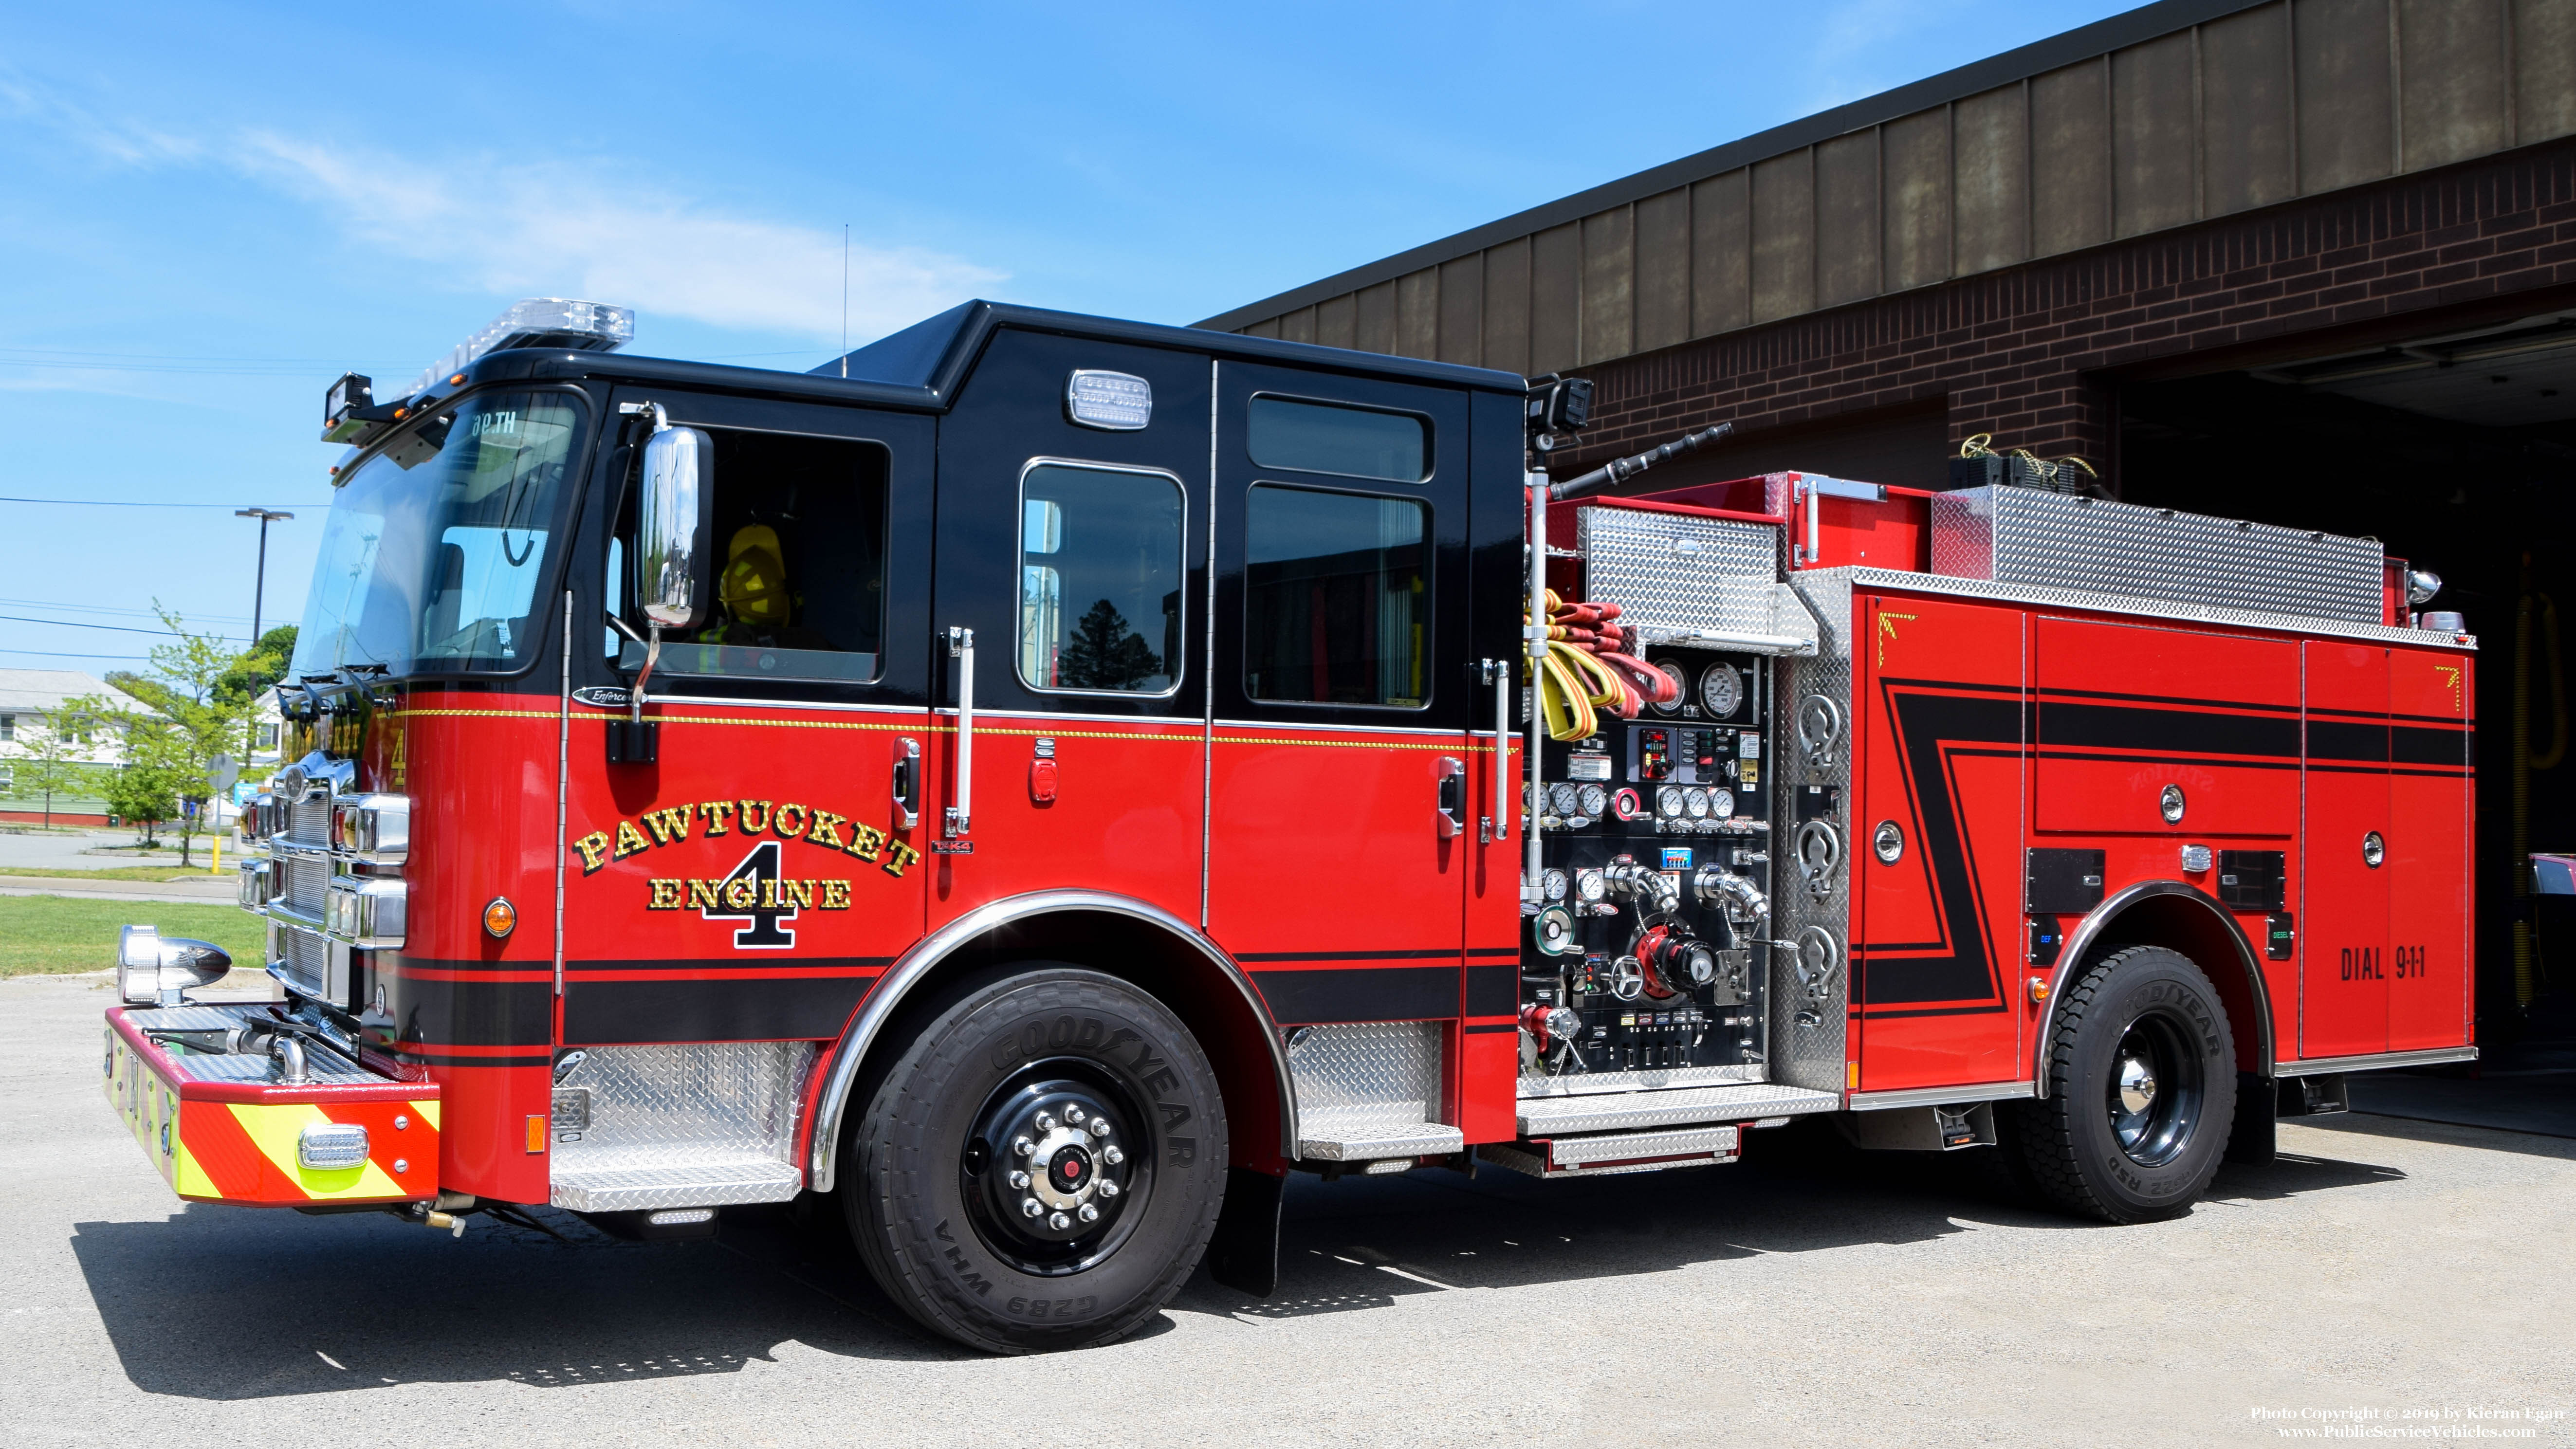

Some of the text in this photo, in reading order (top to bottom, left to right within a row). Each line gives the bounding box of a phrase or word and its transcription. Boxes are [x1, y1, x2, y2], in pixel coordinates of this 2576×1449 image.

[391, 729, 405, 786] 4
[572, 800, 921, 877] PAWTUCKET
[646, 879, 851, 911] ENGINE
[701, 841, 798, 949] 4
[2341, 947, 2384, 981] DIAL
[2111, 984, 2220, 1057] GOODYEAR
[991, 1013, 1197, 1169] GOODYEAR
[2108, 1156, 2142, 1192] RSD
[934, 1217, 994, 1297] WHA
[1006, 1295, 1098, 1317] G289
